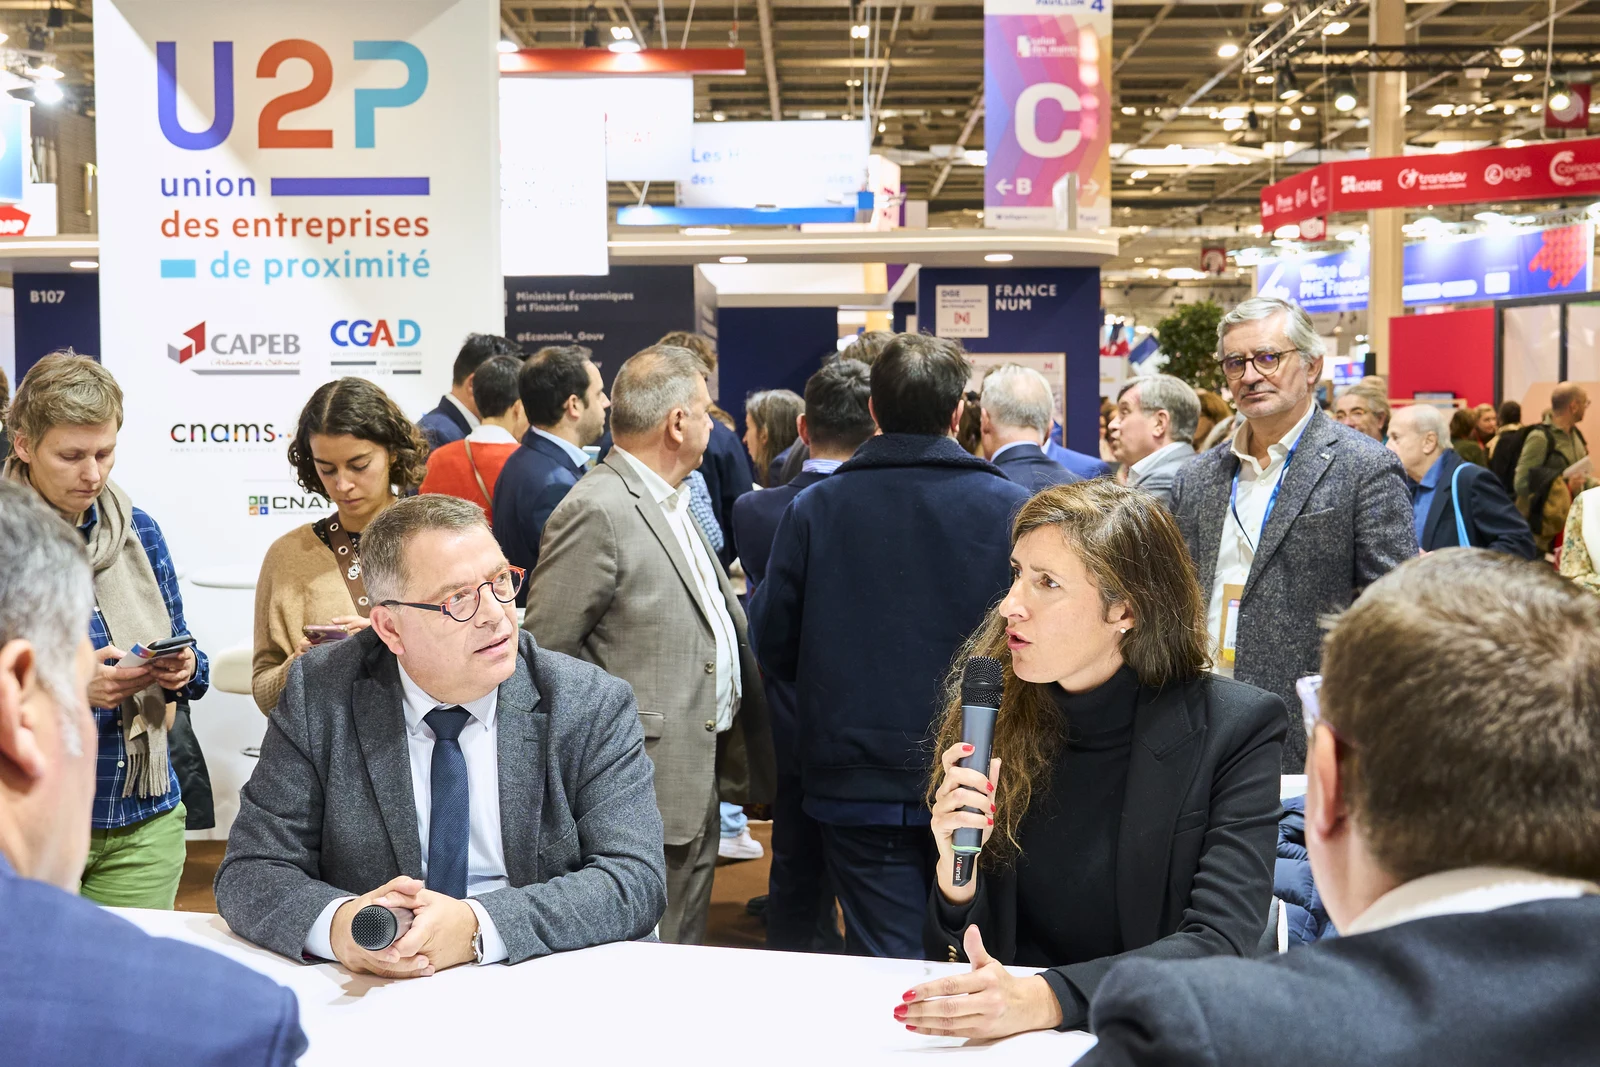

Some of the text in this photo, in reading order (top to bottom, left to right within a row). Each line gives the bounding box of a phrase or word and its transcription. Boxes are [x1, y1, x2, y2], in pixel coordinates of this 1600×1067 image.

[1090, 0, 1105, 12] 4
[156, 38, 429, 151] U2P
[1014, 82, 1082, 159] C
[690, 145, 722, 164] Les
[1418, 170, 1468, 185] transdev
[1504, 163, 1532, 182] egis
[161, 169, 256, 197] union
[1015, 177, 1032, 195] B
[161, 209, 430, 245] des entreprises
[209, 249, 430, 284] de proximité
[30, 290, 65, 304] B107
[516, 290, 634, 303] Ministères Économiques
[995, 284, 1057, 297] FRANCE
[516, 302, 579, 313] et Financiers
[995, 298, 1032, 311] NUM
[330, 318, 422, 347] CGAD
[210, 333, 301, 355] CAPEB
